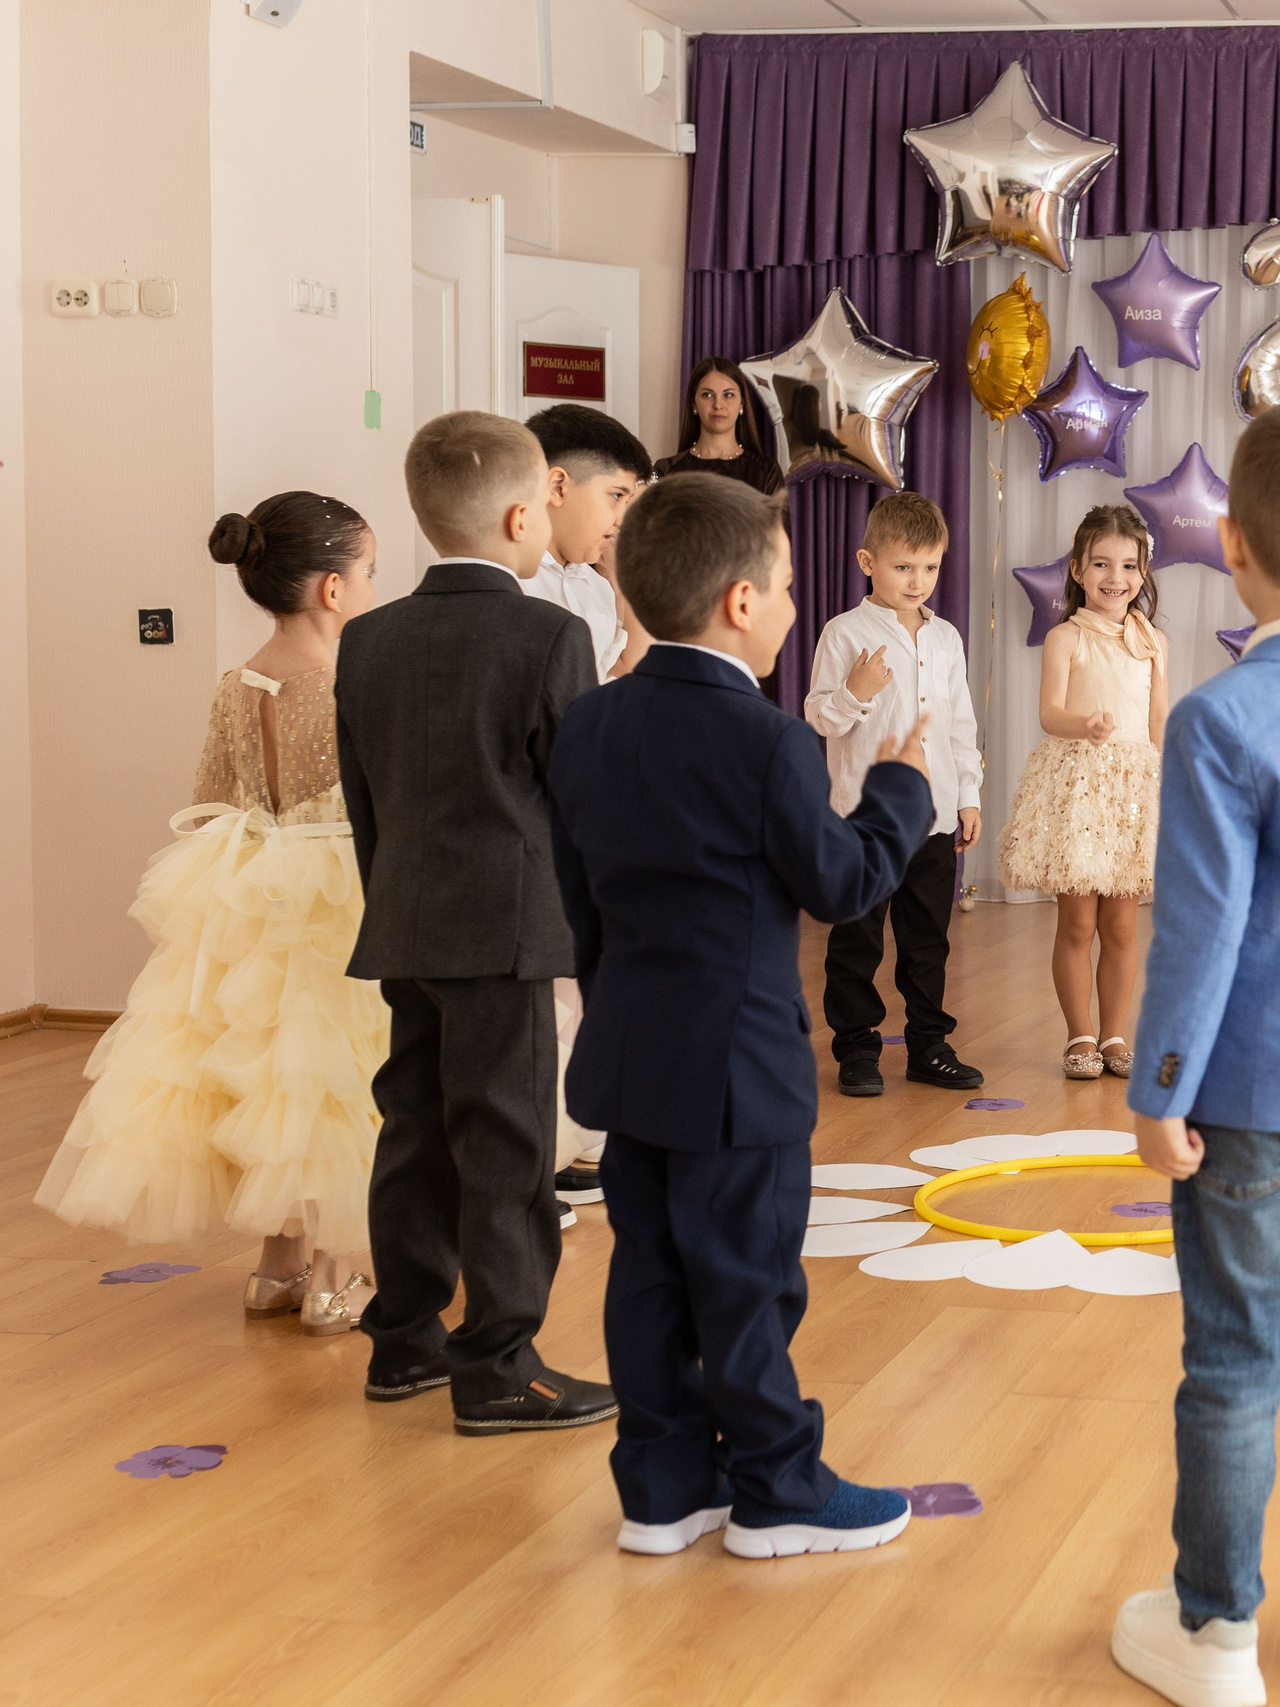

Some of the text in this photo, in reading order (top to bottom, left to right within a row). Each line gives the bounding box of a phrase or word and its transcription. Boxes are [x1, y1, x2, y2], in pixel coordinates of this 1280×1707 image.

[1124, 306, 1162, 320] Аиза
[530, 356, 601, 372] МУЗЫКАЛЬНЫЙ
[557, 373, 575, 385] ЗАЛ
[1065, 418, 1108, 432] Арман
[1172, 514, 1211, 529] Артём
